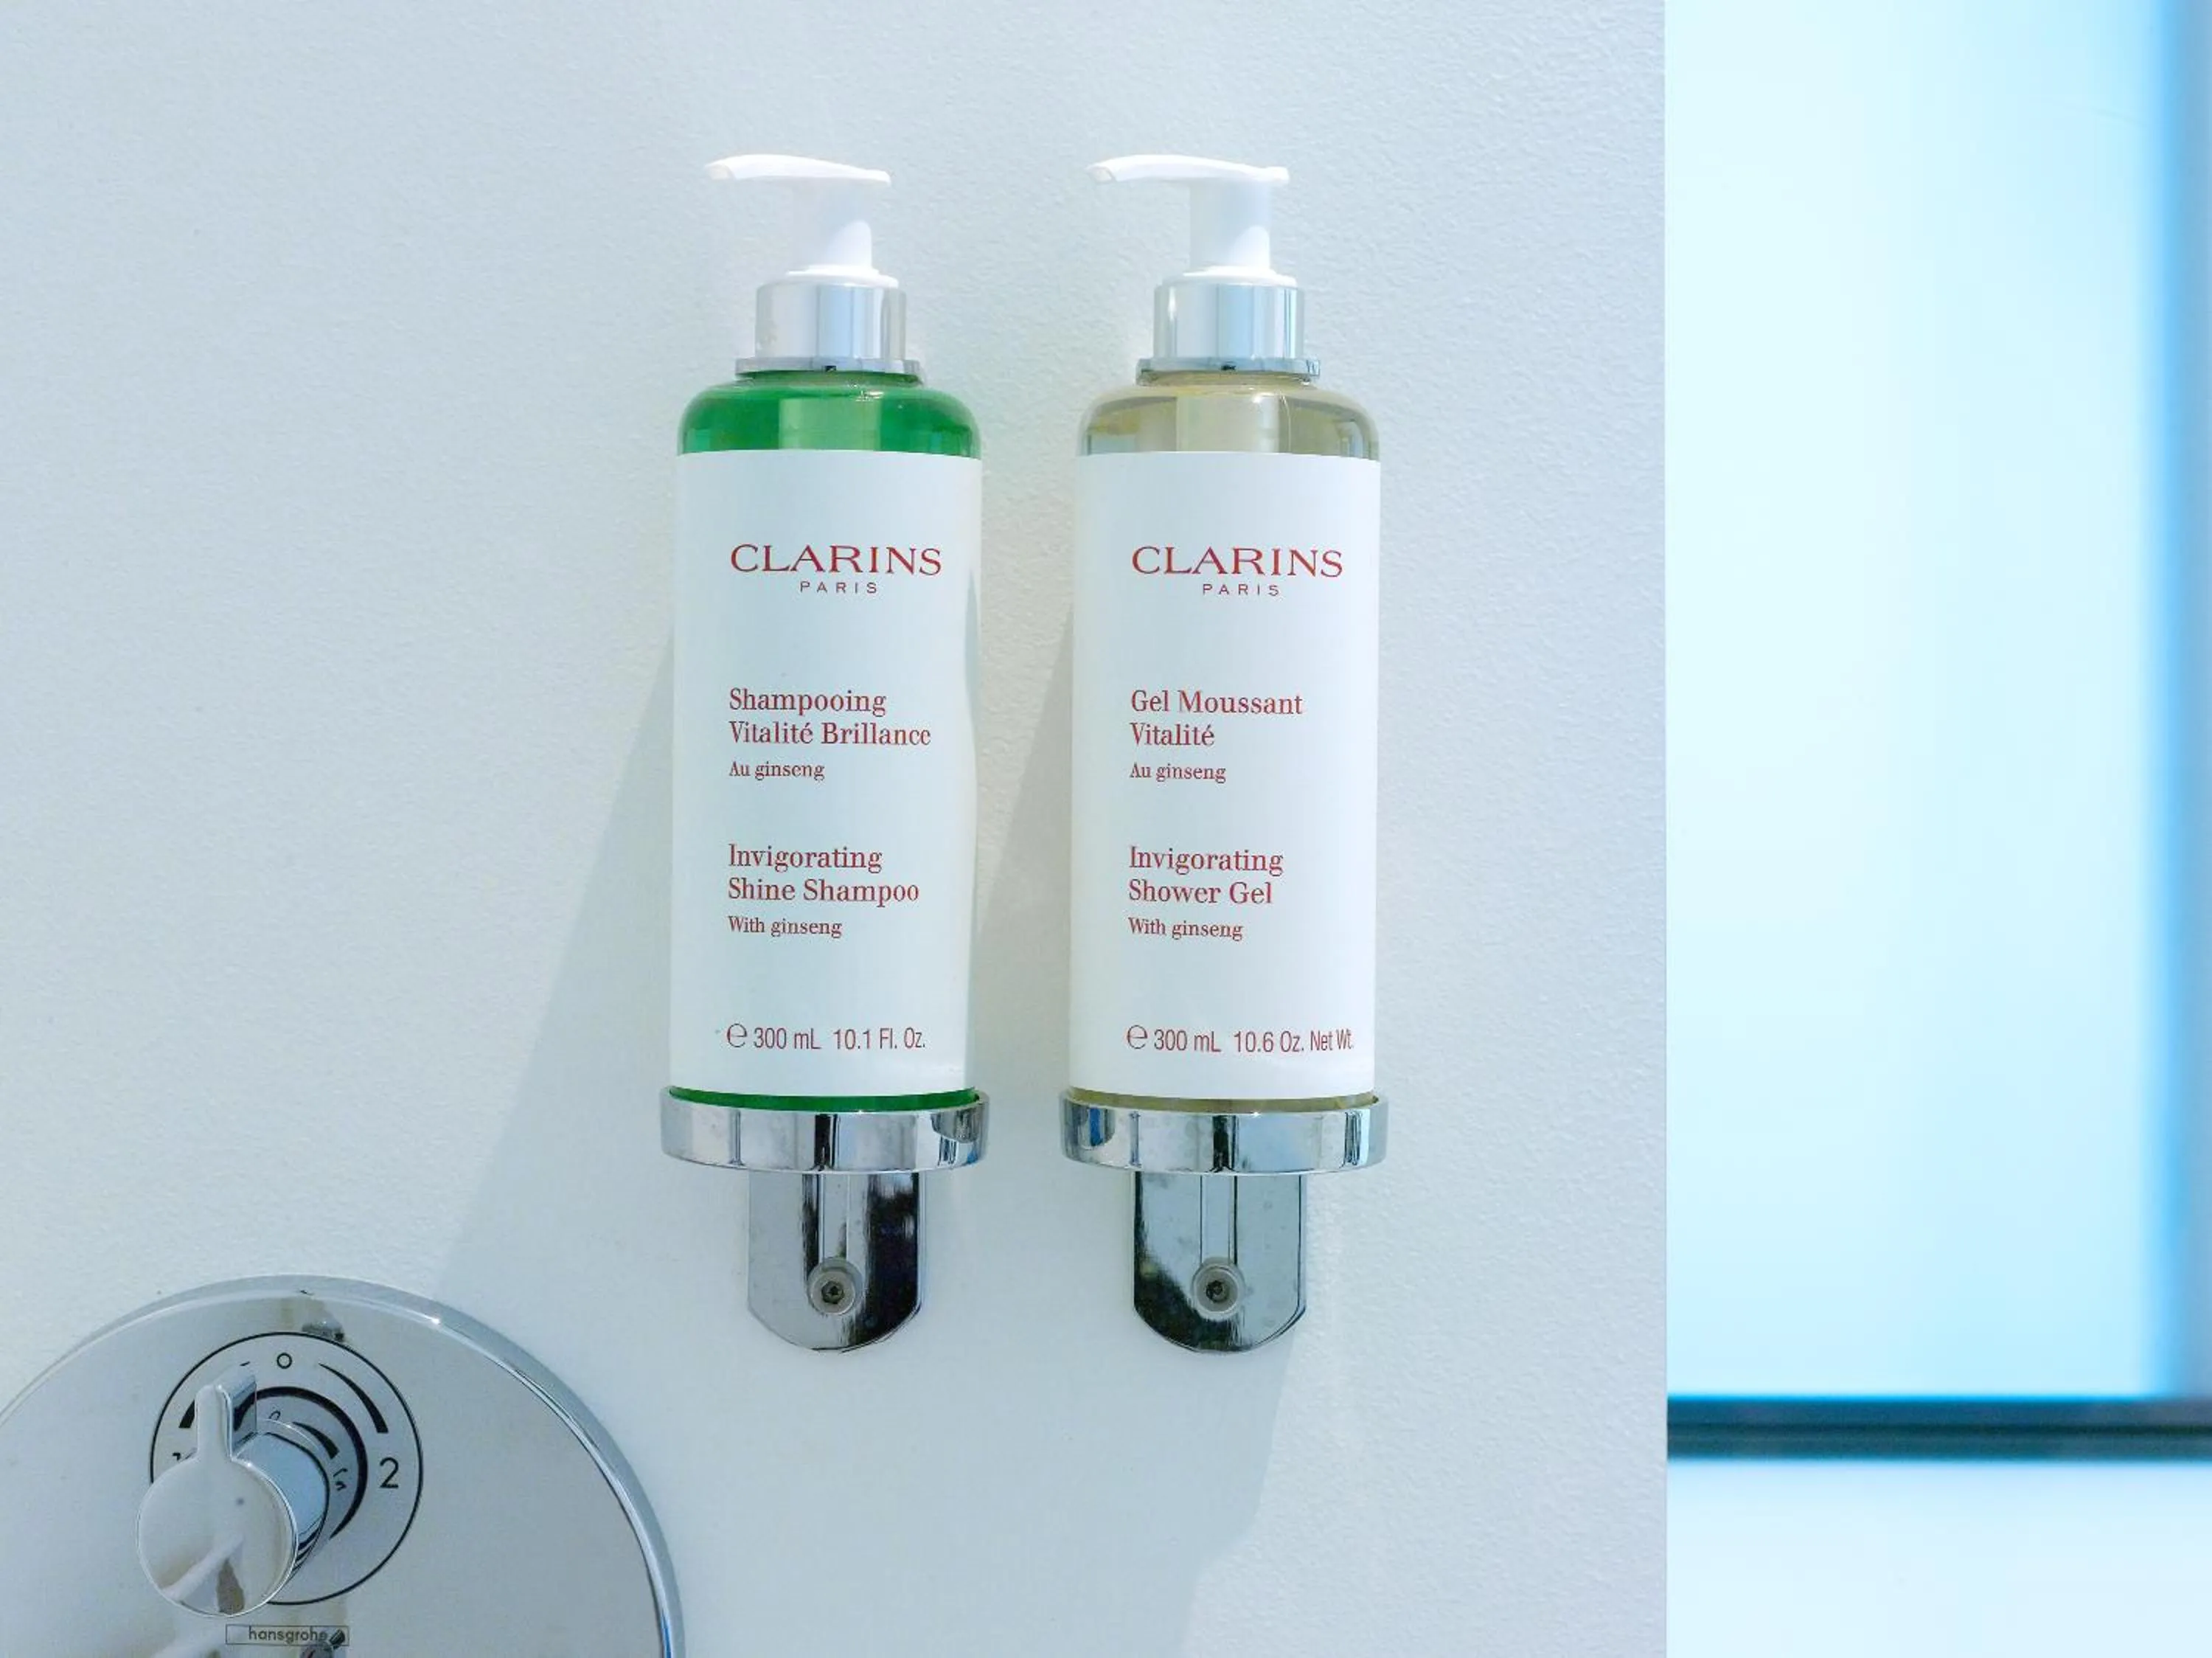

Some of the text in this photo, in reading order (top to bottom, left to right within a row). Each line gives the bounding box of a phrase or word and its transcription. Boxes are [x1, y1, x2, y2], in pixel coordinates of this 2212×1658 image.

[731, 544, 942, 575] CLARINS
[1133, 546, 1343, 577] CLARINS
[800, 581, 877, 594] PARIS
[1203, 583, 1279, 596] PARIS
[730, 687, 886, 718] Shampooing
[1131, 690, 1303, 715] Gel Moussant
[728, 721, 931, 746] Vitalité Brillance
[1129, 722, 1214, 746] Vitalité
[729, 761, 824, 782] Au ginseng
[1130, 763, 1226, 784] Au ginseng
[728, 844, 882, 873] Invigorating
[1129, 846, 1284, 877] Invigorating
[728, 877, 919, 908] Shine Shampoo
[1129, 879, 1271, 904] Shower Gel
[727, 915, 842, 939] With ginseng
[1128, 917, 1243, 942] With ginseng
[754, 1027, 787, 1049] 300
[794, 1028, 821, 1050] mL
[833, 1029, 870, 1050] 10.1
[880, 1028, 897, 1049] Fl.
[904, 1027, 925, 1049] Oz.
[1154, 1029, 1187, 1051] 300
[1194, 1031, 1222, 1052] mL
[1234, 1031, 1274, 1052] 10.6
[1280, 1030, 1304, 1052] Oz.
[1310, 1030, 1333, 1051] Net
[380, 1457, 399, 1489] 2
